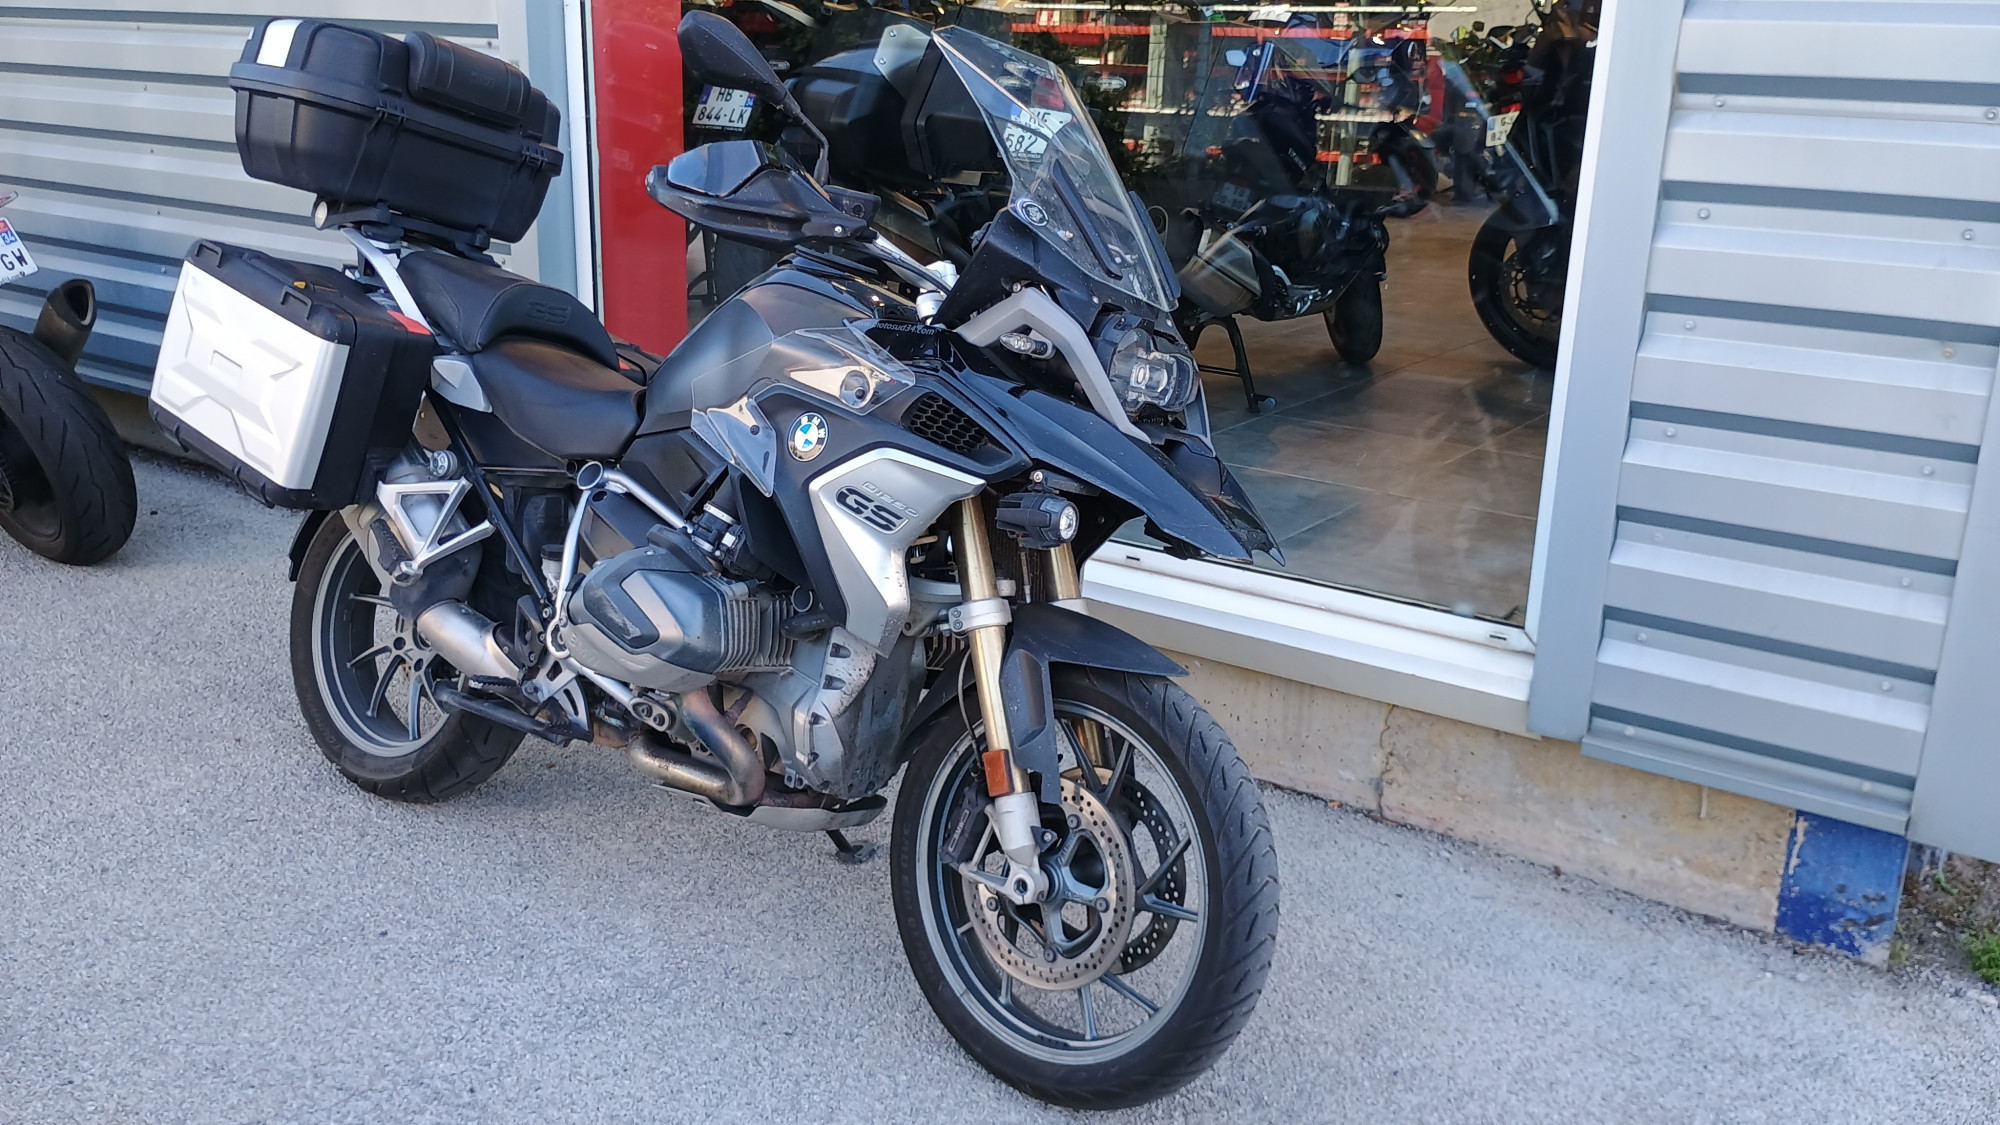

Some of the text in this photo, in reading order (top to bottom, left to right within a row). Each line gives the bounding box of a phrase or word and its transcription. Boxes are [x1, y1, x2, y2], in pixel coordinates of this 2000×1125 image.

[697, 106, 748, 125] 844-LK
[1006, 133, 1037, 153] 582
[0, 248, 28, 271] GW
[836, 487, 904, 532] GS
